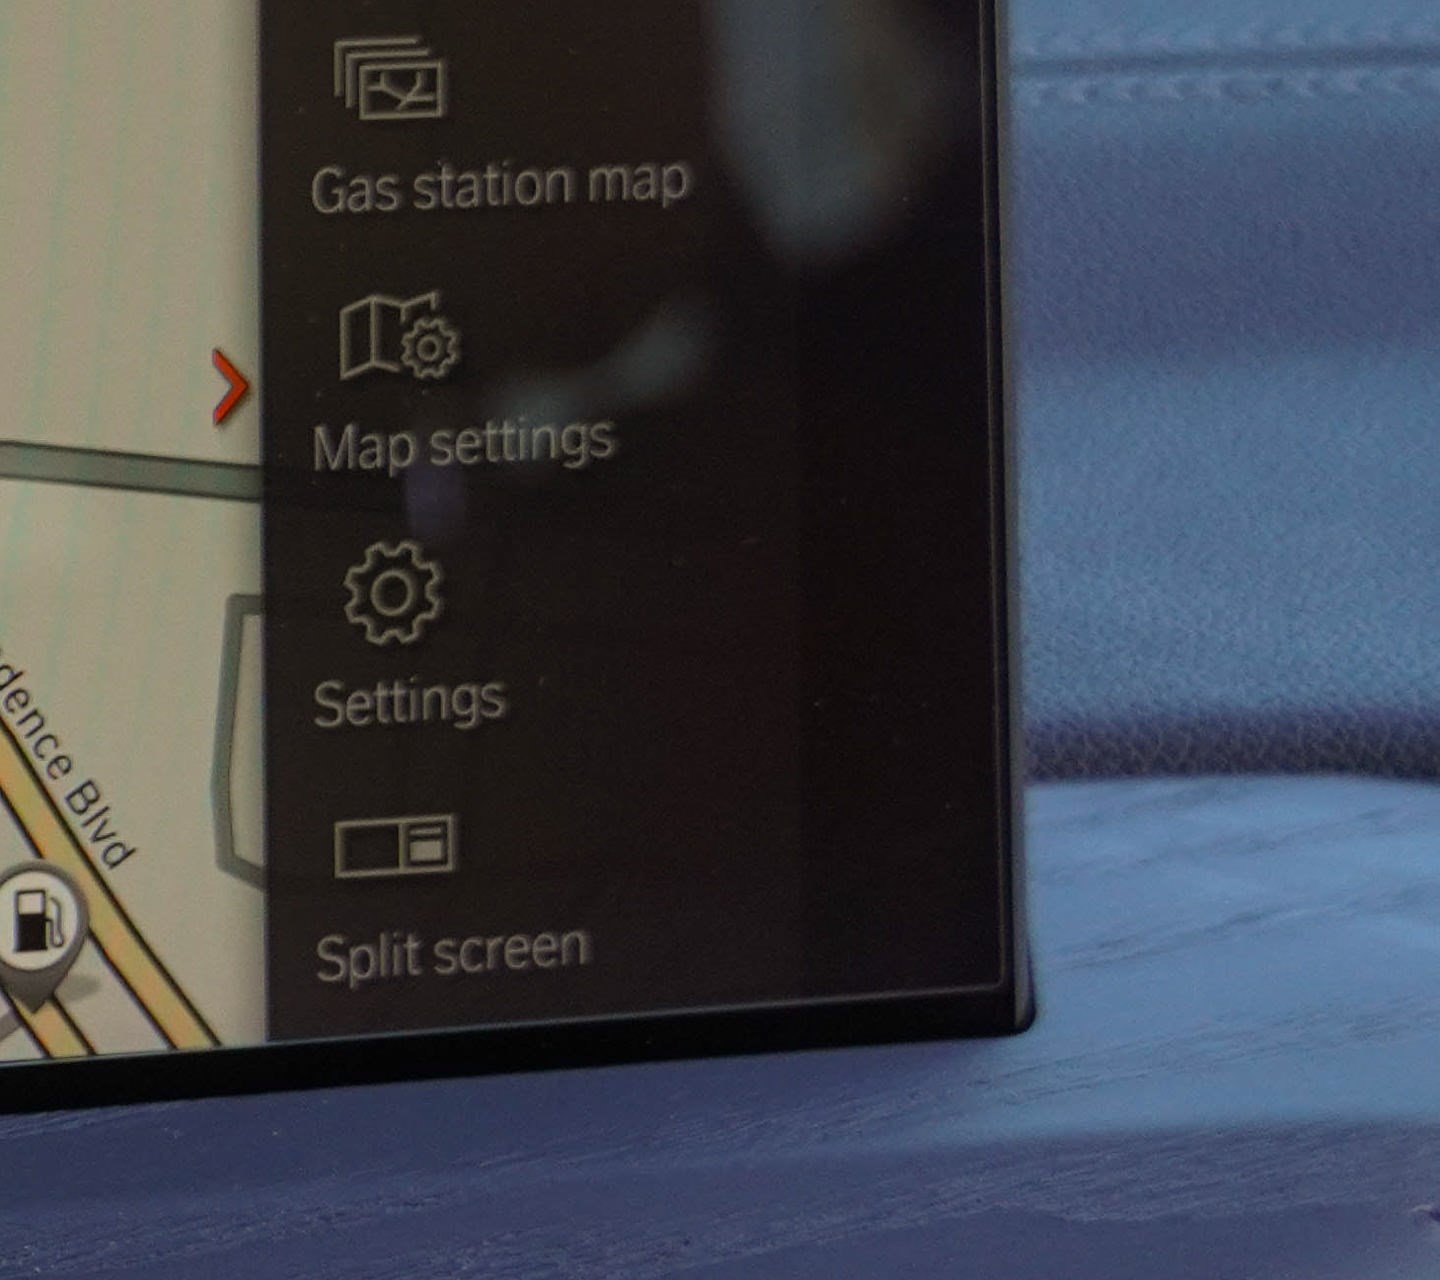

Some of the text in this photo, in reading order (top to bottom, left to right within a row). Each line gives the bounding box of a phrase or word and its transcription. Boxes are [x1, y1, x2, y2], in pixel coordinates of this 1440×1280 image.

[310, 160, 695, 215] Gas station map
[312, 418, 620, 478] Map settings
[313, 677, 509, 730] Settings
[64, 779, 137, 871] Blvd
[315, 930, 594, 988] Split screen
